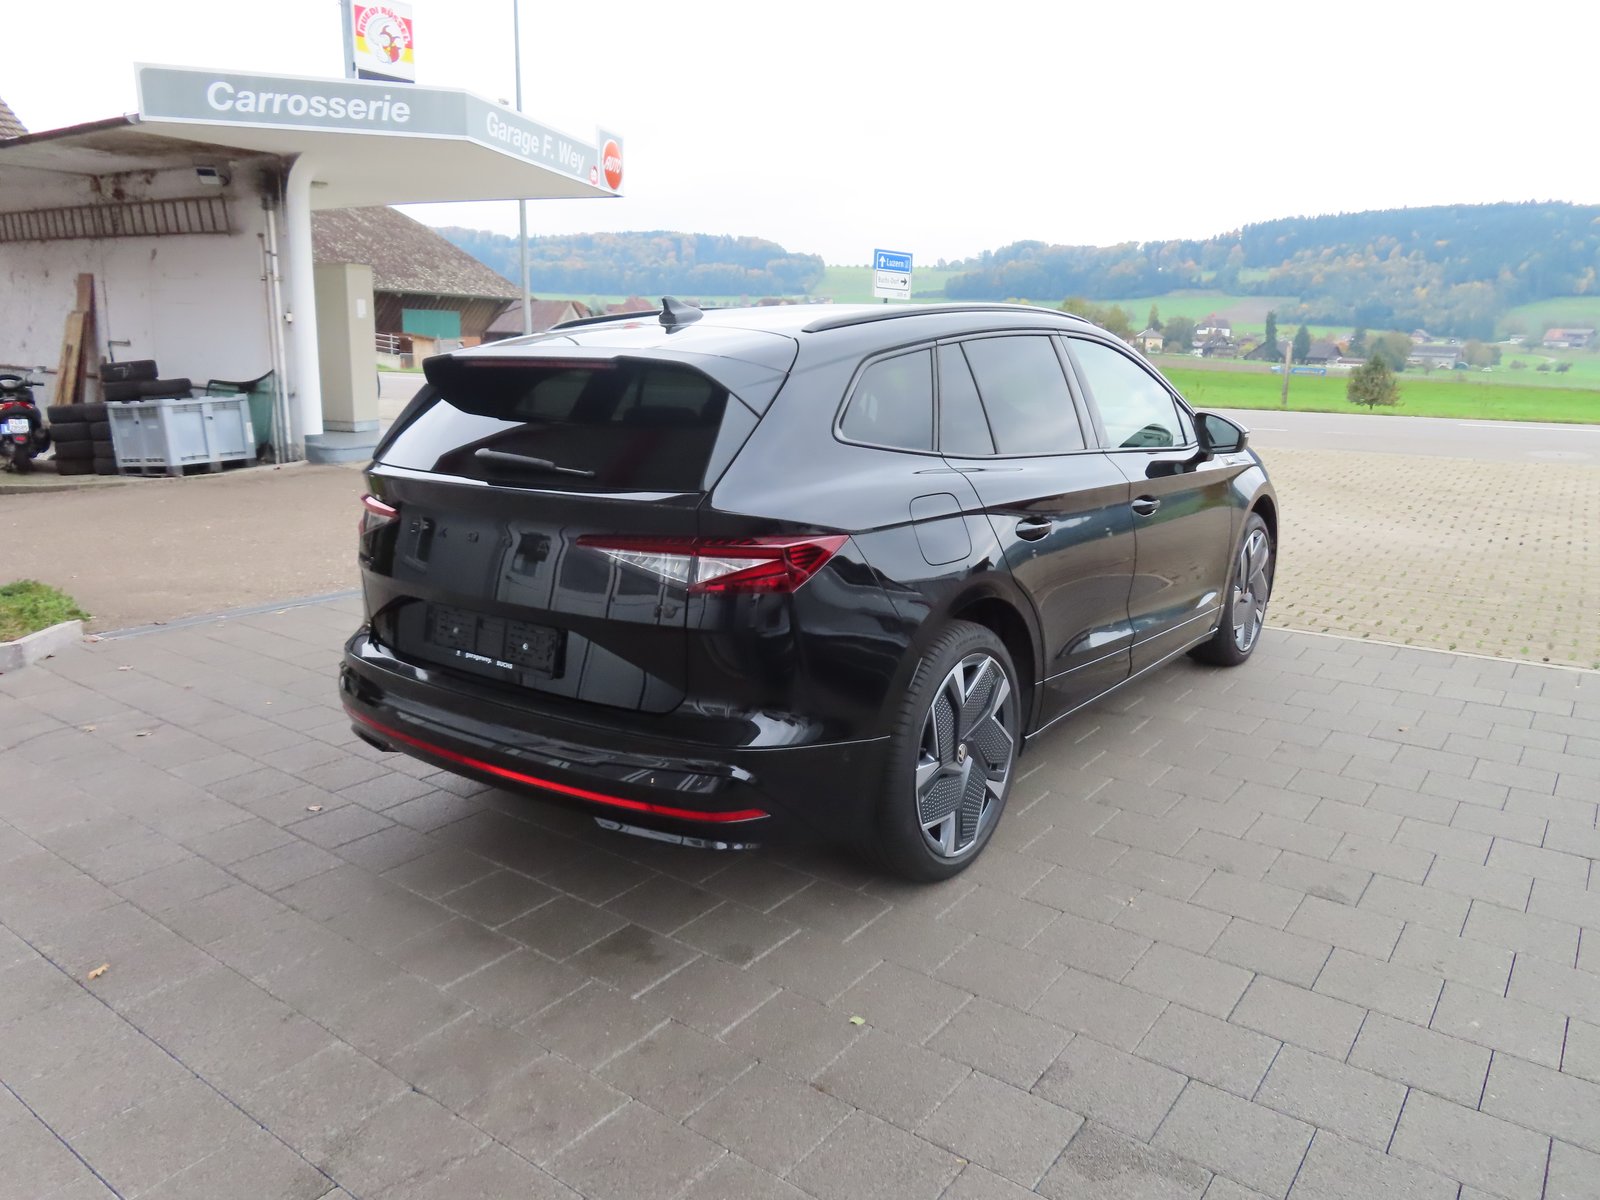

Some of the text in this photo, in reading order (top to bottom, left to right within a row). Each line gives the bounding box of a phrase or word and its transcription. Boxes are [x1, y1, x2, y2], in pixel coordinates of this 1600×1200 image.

[360, 6, 379, 31] RUEDI
[206, 81, 411, 123] Carrosserie
[487, 111, 584, 174] Garage F. Wey
[605, 156, 622, 174] AUTO
[886, 257, 904, 268] Luzern
